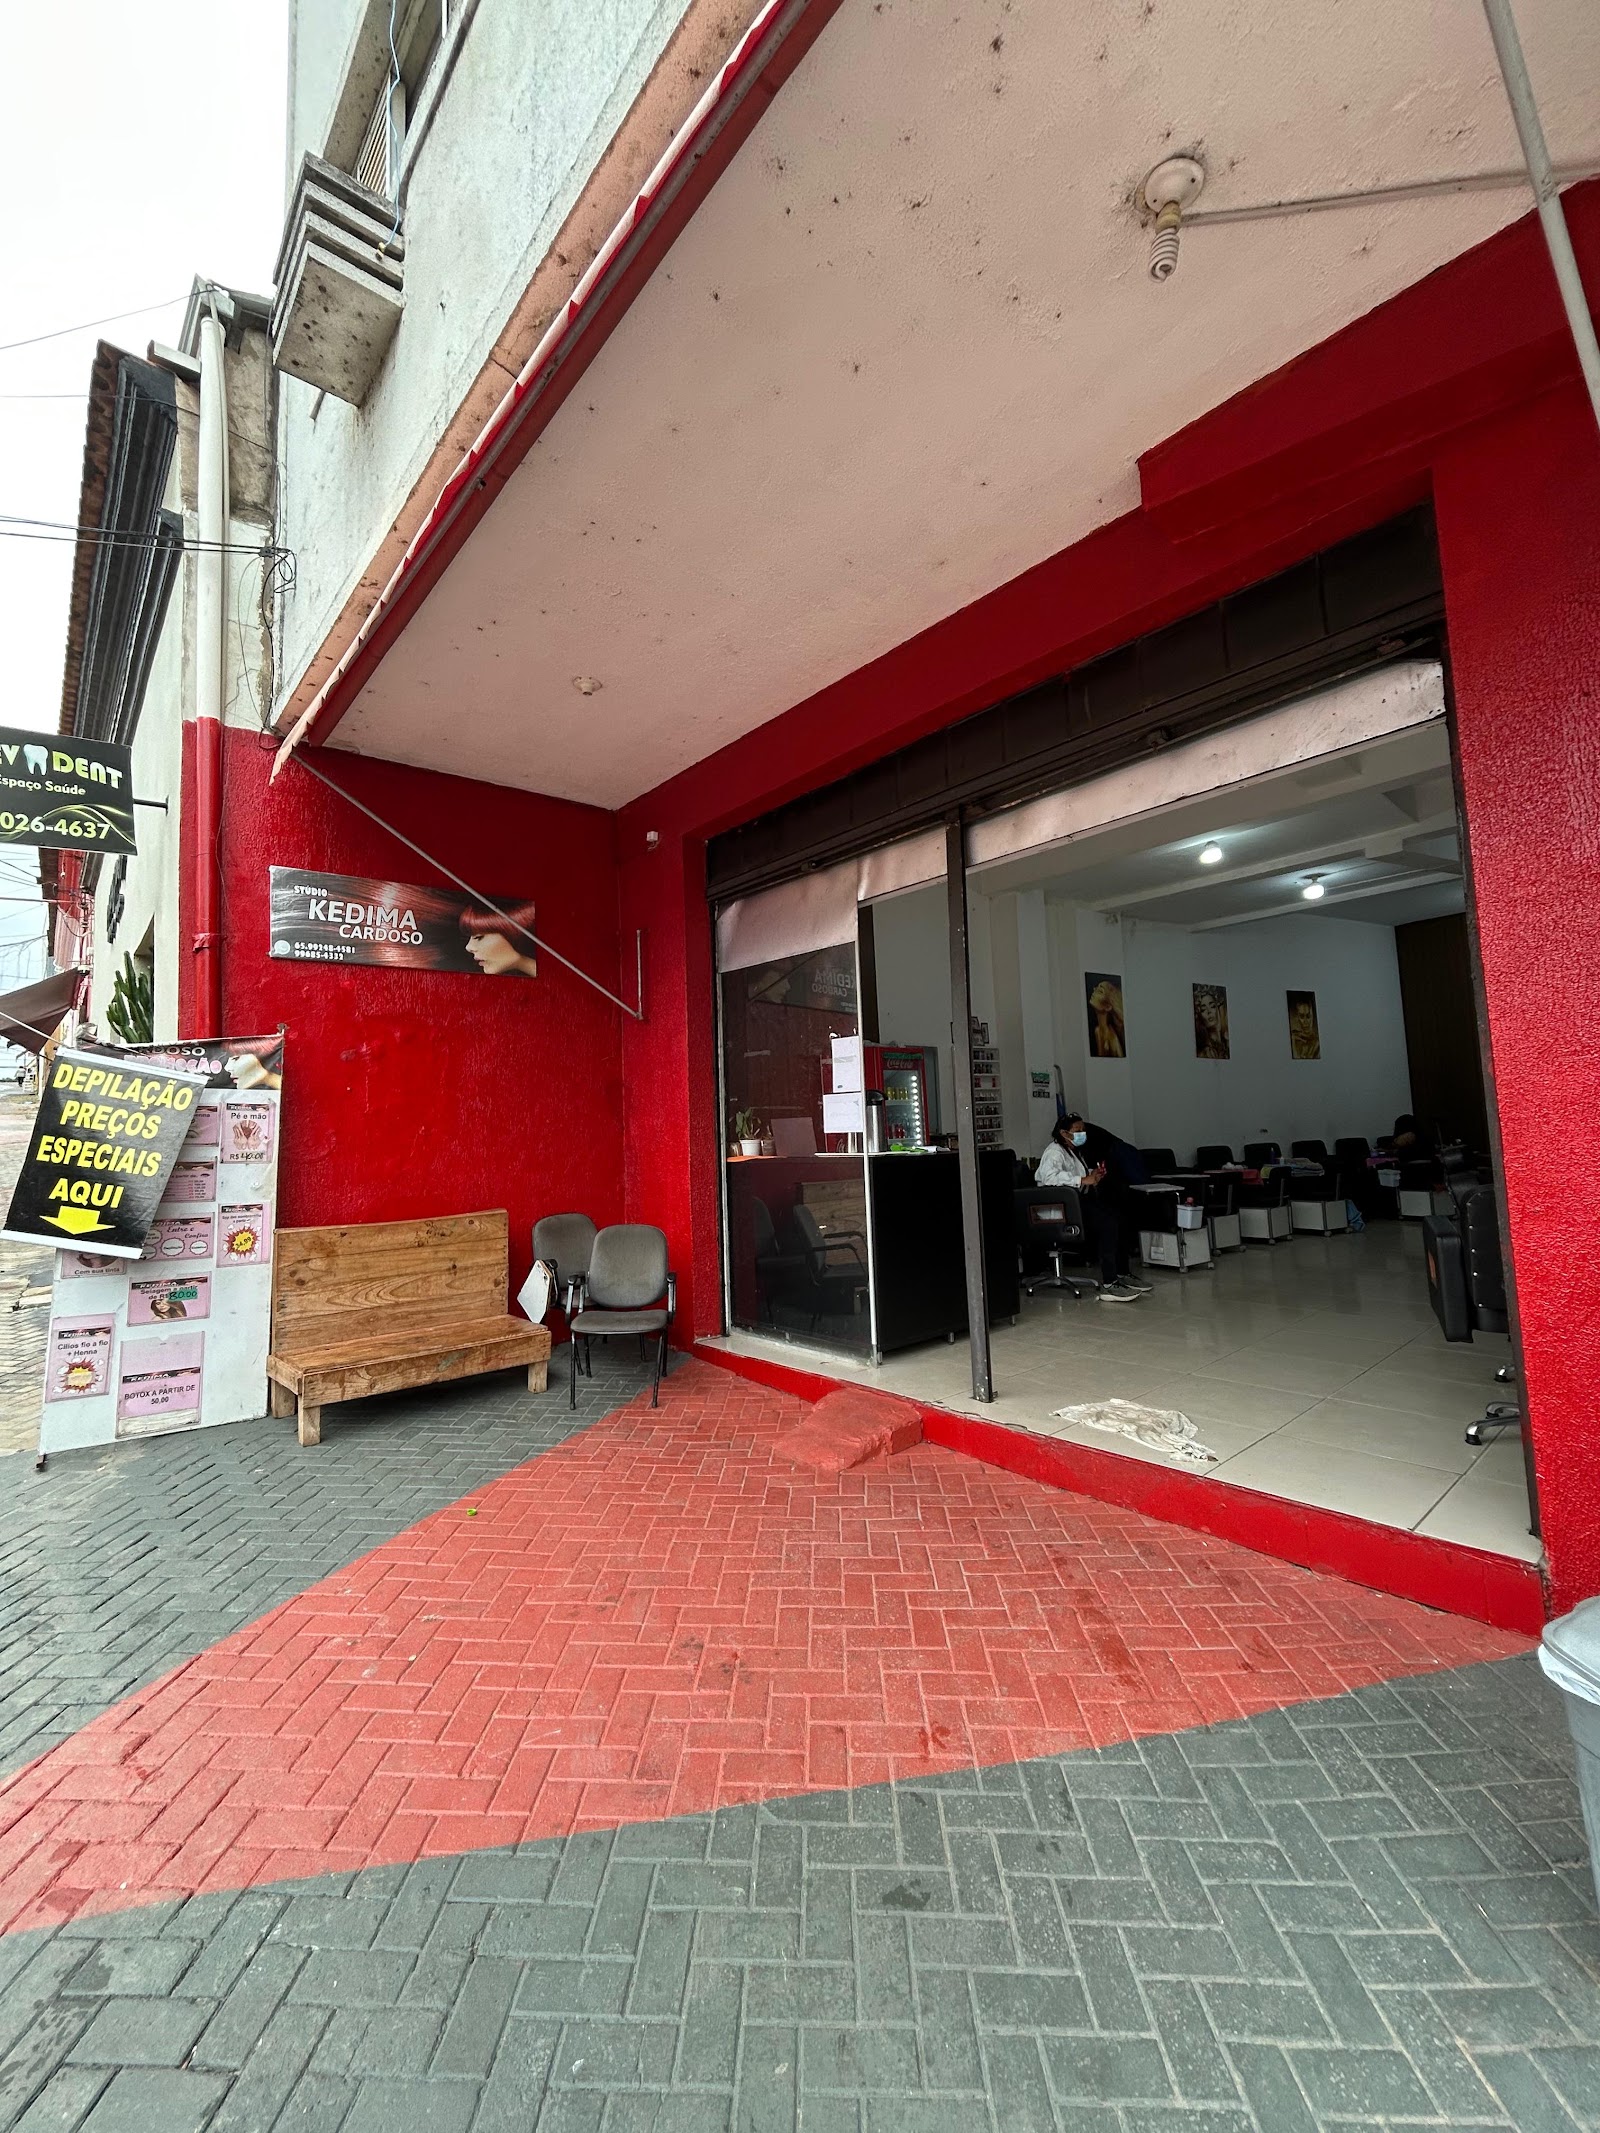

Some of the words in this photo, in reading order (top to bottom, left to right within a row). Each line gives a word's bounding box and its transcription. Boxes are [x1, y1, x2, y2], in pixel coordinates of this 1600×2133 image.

[0, 744, 20, 766] V
[52, 750, 122, 789] DENT
[0, 774, 42, 792] spaço
[45, 780, 86, 796] Saúde
[308, 898, 417, 931] KEDIMA
[339, 924, 423, 945] CARDOSO
[53, 1063, 193, 1111] DEPILAÇÃO
[60, 1100, 162, 1139] PREÇOS
[36, 1135, 162, 1177] ESPECIAIS
[49, 1177, 124, 1209] AQUI
[124, 1391, 150, 1400] BOTOX
[158, 1386, 184, 1395] PARTIR
